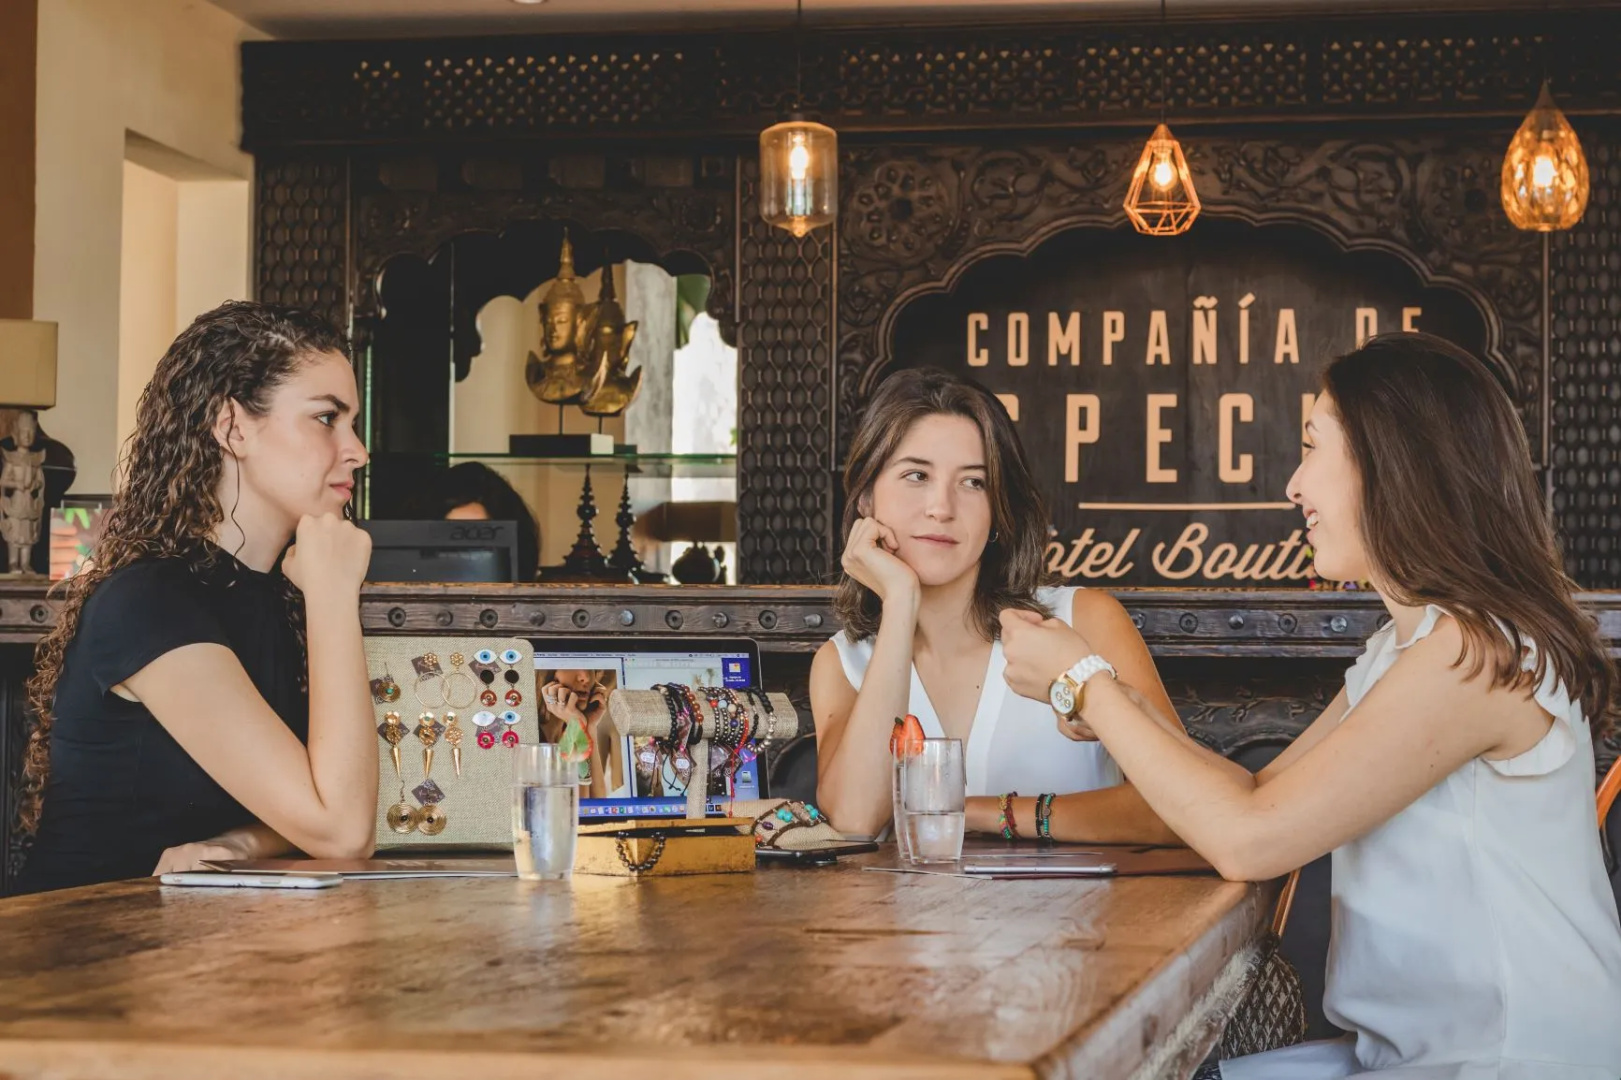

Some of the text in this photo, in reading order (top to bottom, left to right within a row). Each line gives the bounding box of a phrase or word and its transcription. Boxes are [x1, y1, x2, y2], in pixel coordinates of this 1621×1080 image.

[967, 293, 1300, 367] COMPAÑÍA
[993, 393, 1314, 483] PEC
[1044, 522, 1311, 580] otel Bouti
